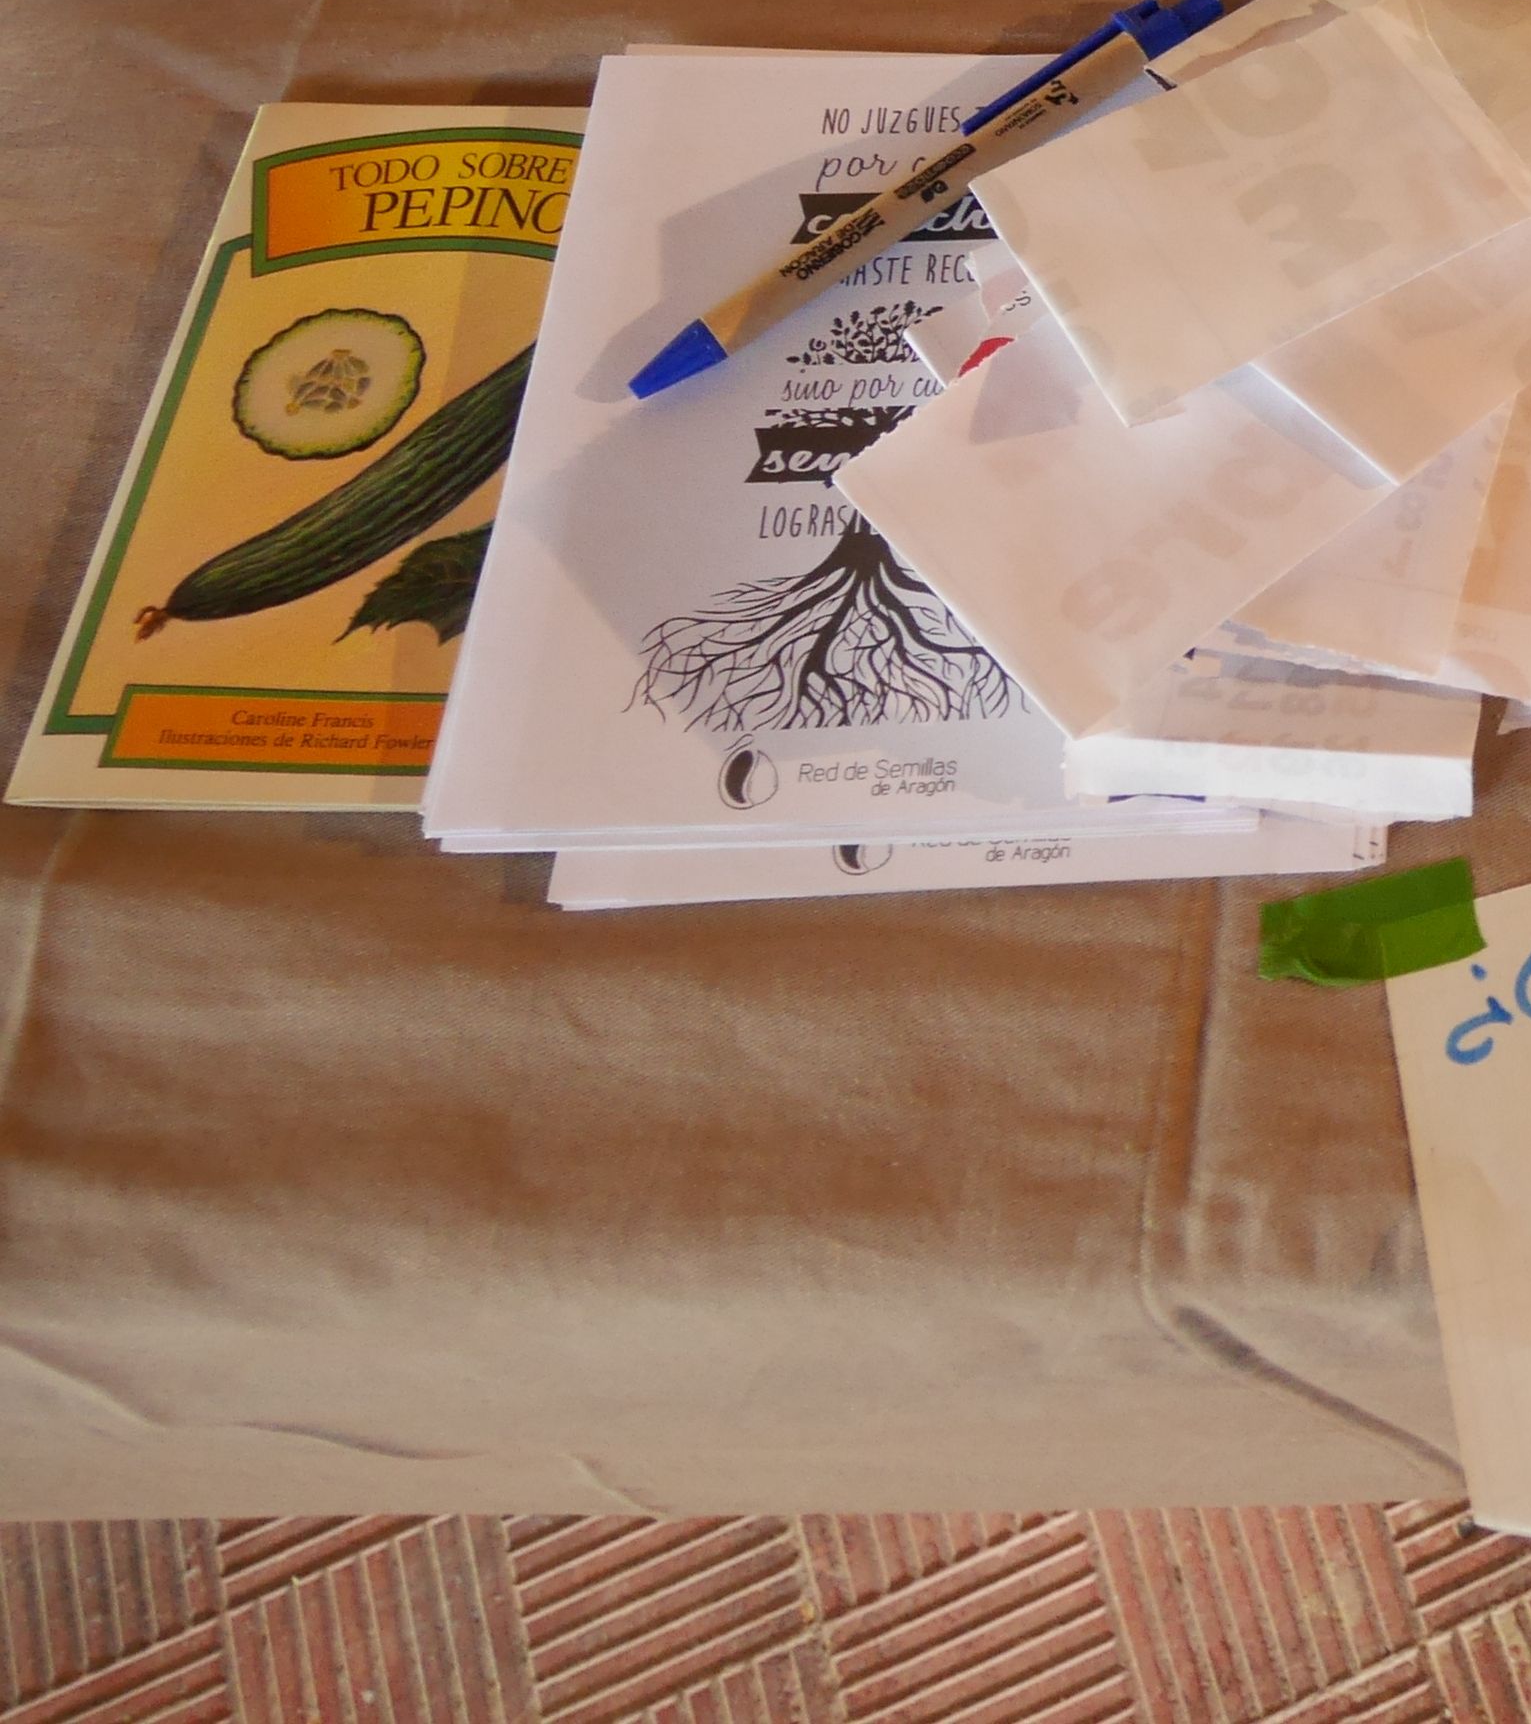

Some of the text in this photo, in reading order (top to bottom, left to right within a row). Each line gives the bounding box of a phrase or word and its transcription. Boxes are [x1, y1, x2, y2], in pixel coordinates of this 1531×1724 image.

[821, 105, 962, 135] NO JUZGUES
[330, 151, 573, 192] TODO SOBRE
[816, 154, 896, 192] por
[849, 376, 902, 404] por
[230, 708, 376, 730] Caroline Francis
[157, 728, 270, 749] Ilustraciones
[274, 730, 295, 749] de
[300, 731, 368, 751] Richard
[796, 757, 958, 783] Red de Semillas
[870, 776, 957, 797] de Aragón
[985, 845, 1007, 862] de
[1011, 842, 1072, 862] Aragón
